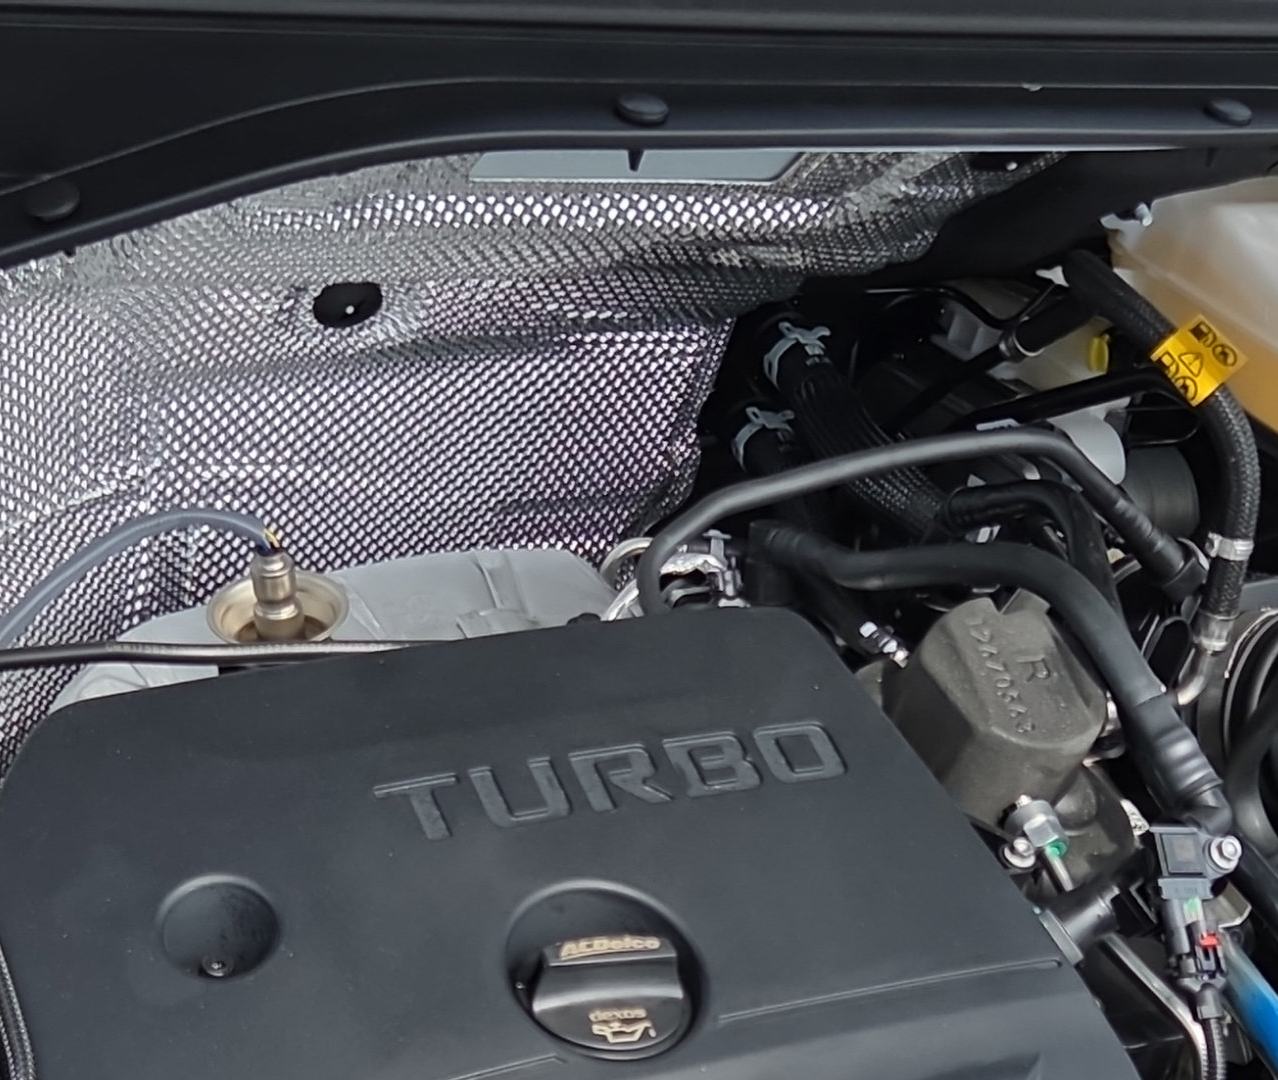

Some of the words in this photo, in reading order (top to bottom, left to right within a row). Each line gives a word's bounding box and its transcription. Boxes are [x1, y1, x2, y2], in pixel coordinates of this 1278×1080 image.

[373, 720, 847, 840] TURBO
[560, 936, 661, 960] ACDelco
[588, 1008, 647, 1023] dexos
